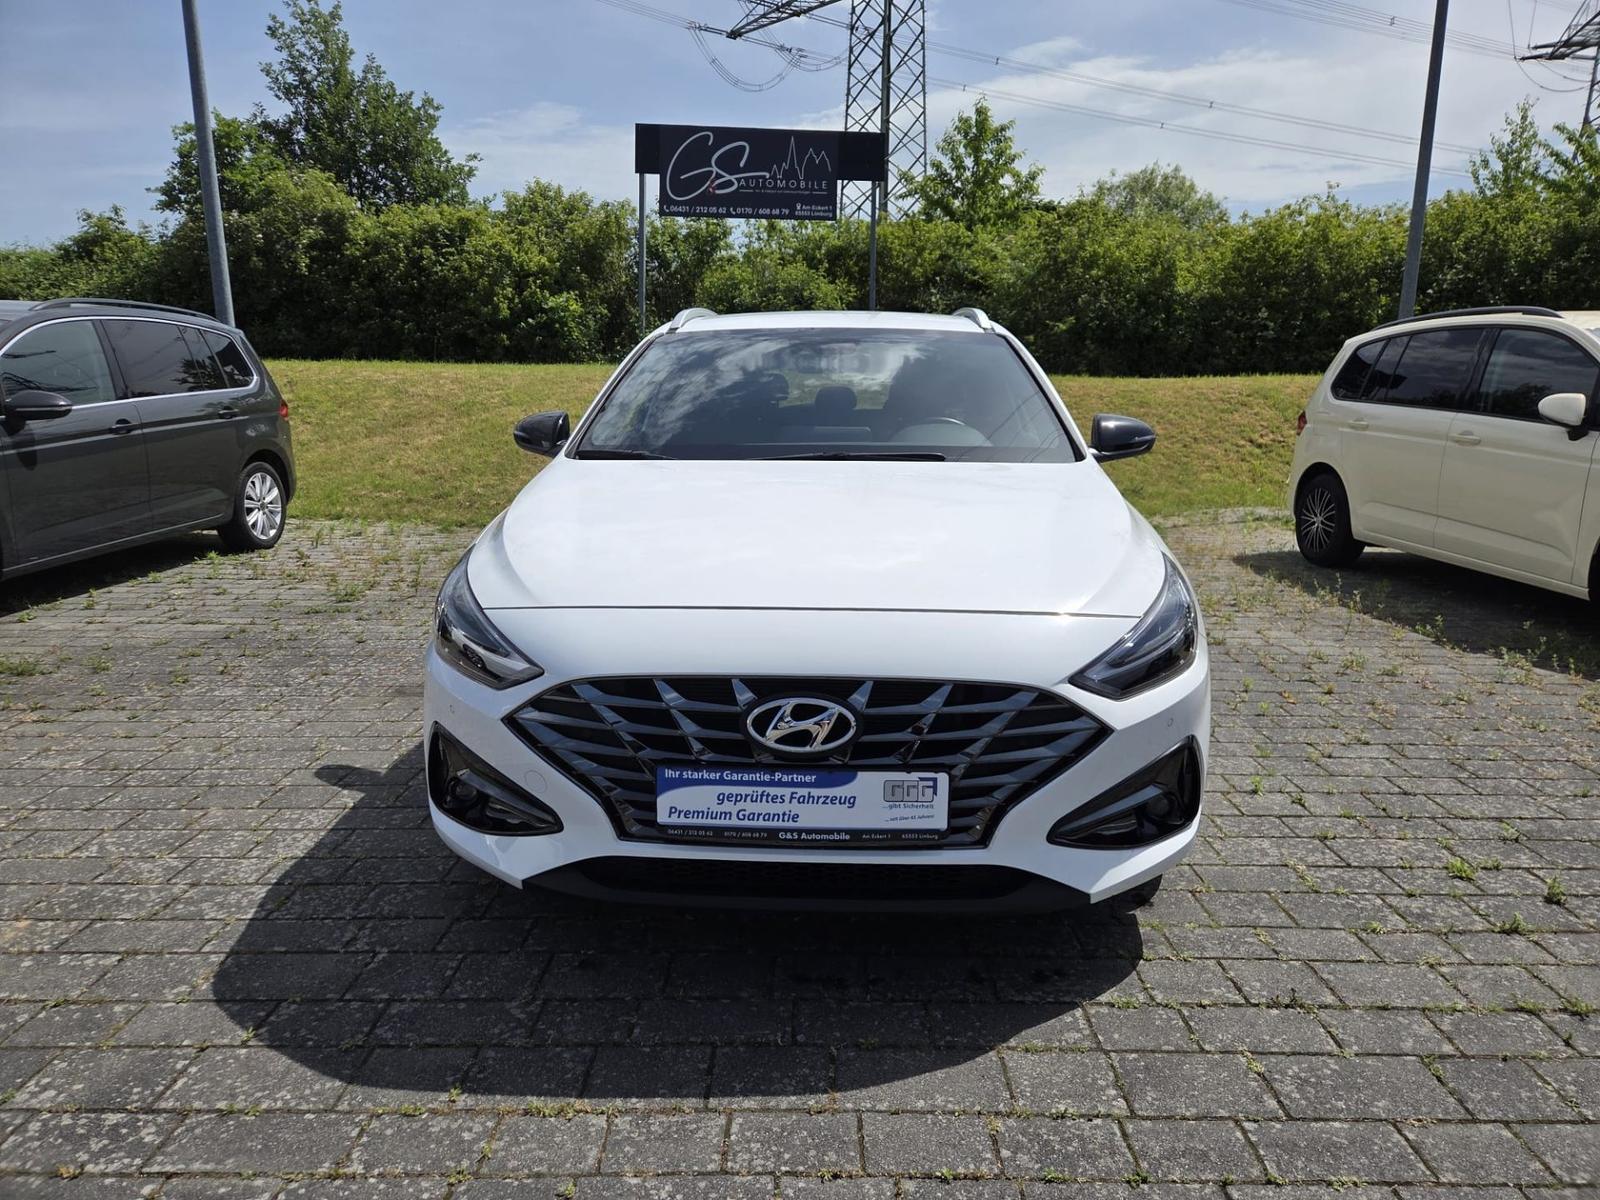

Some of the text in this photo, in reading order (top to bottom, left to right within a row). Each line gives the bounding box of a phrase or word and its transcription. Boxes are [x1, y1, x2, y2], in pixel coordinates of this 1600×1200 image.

[739, 178, 828, 189] AUTOMOBILE
[669, 205, 690, 213] 06431
[695, 206, 708, 214] 212
[708, 206, 717, 214] 05
[718, 206, 727, 214] 62
[736, 207, 753, 215] 0170
[758, 207, 771, 216] 608
[772, 208, 780, 216] 68
[781, 208, 790, 216] 79
[664, 768, 817, 783] Ihr starker Garantie-Partner
[716, 790, 857, 809] geprüftes Fahrzeug
[668, 806, 800, 823] Premium Garantie
[778, 831, 850, 840] G&S Automobile
